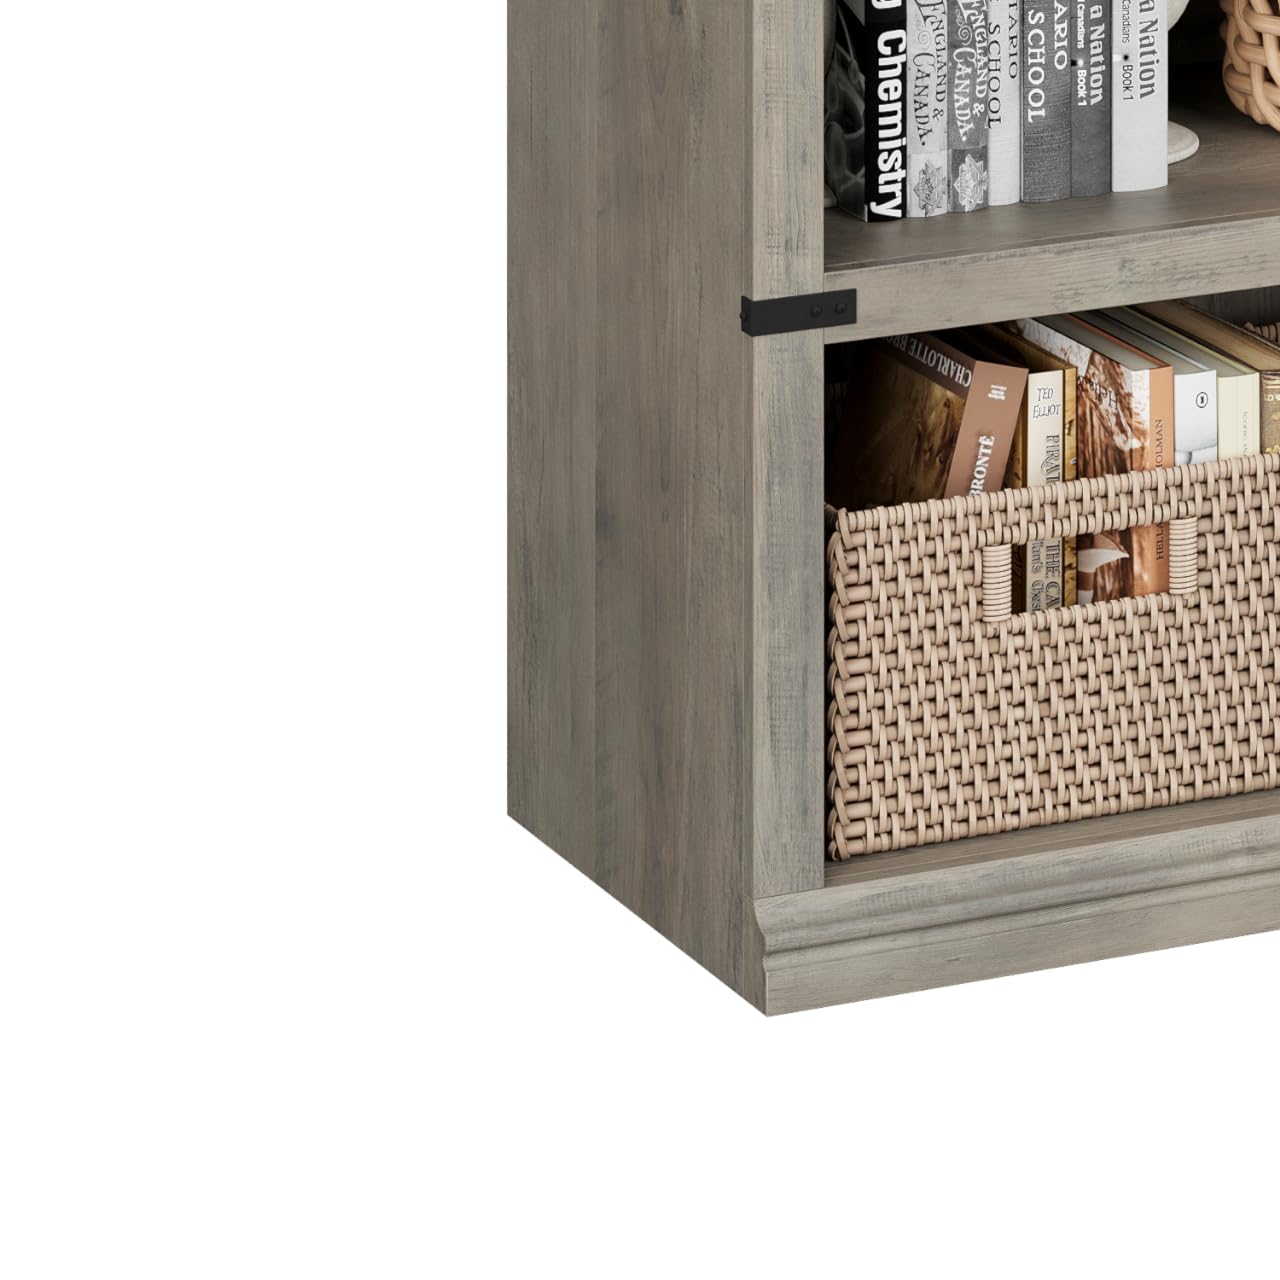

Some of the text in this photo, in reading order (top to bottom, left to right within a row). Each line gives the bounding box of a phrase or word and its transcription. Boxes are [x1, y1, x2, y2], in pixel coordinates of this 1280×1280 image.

[1077, 3, 1085, 49] Canadians
[1090, 5, 1103, 20] a
[1138, 0, 1155, 14] a
[987, 22, 1001, 129] SCHOOL
[1027, 9, 1046, 123] SCHOOL
[1090, 23, 1106, 106] Nation
[1122, 64, 1134, 92] Book
[1139, 17, 1160, 100] Nation
[1077, 69, 1087, 98] Book
[870, 28, 906, 219] Chemistry
[932, 108, 944, 121] &
[972, 102, 985, 117] &
[908, 338, 973, 388] CHARLOTTE
[1032, 404, 1062, 419] ELLIOT
[1037, 387, 1054, 402] TED
[1040, 434, 1061, 483] PIRAT
[1045, 539, 1060, 578] THE
